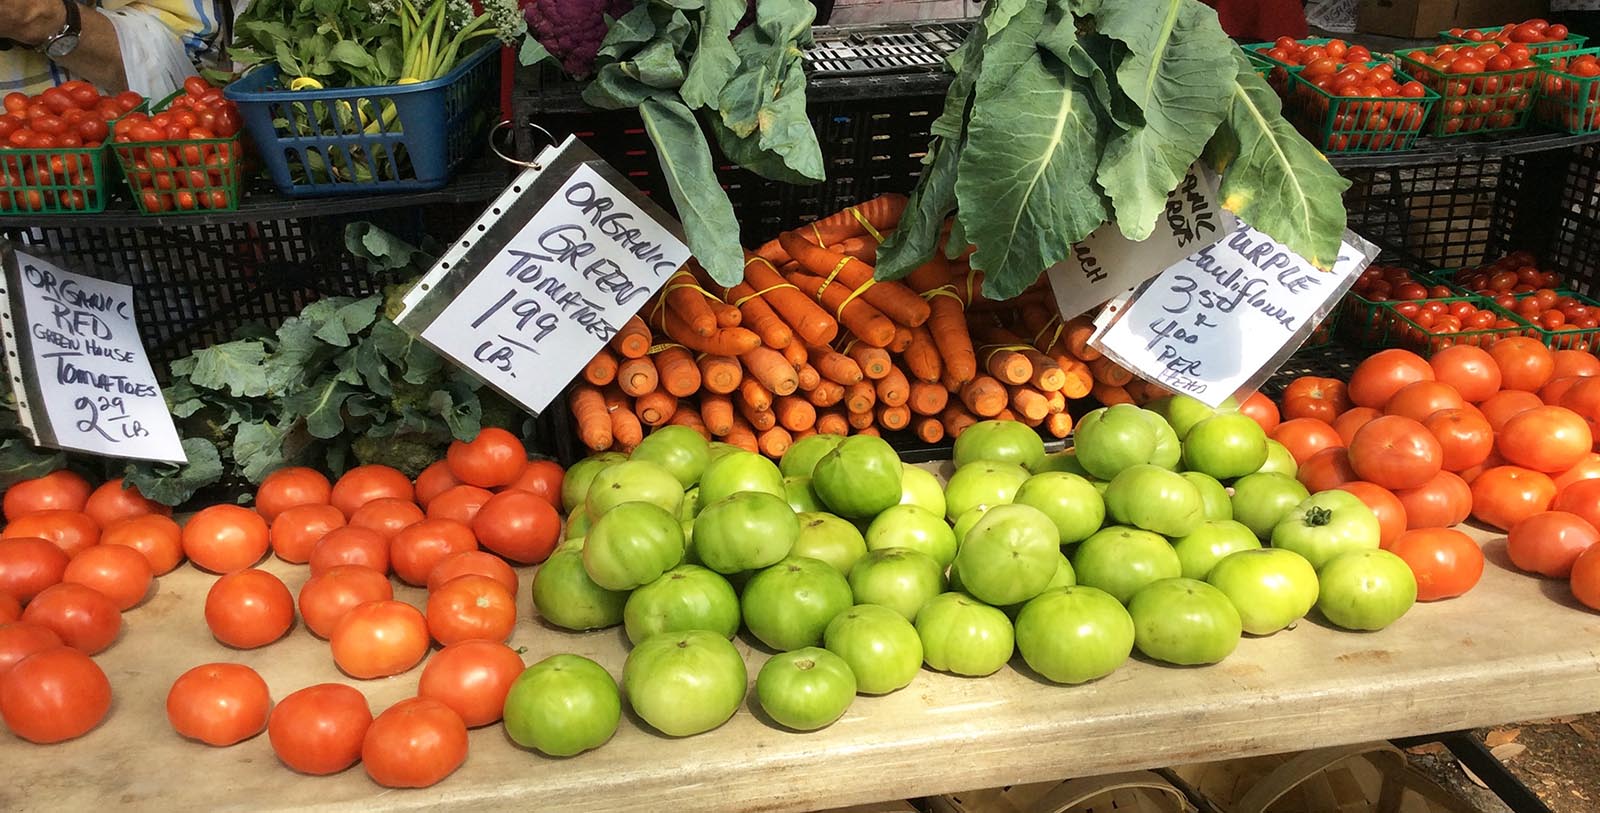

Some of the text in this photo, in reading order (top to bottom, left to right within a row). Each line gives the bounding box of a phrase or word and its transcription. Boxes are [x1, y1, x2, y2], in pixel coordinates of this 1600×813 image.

[564, 181, 677, 277] ORGANIC
[1166, 190, 1195, 249] ROTS
[24, 264, 130, 320] ORGANIC
[537, 224, 651, 306] GREEN
[42, 296, 113, 340] RED
[507, 249, 619, 343] TOMATOES
[33, 323, 136, 363] GREEN HOUSE
[1156, 344, 1202, 377] PER
[42, 352, 158, 398] TOMATOES
